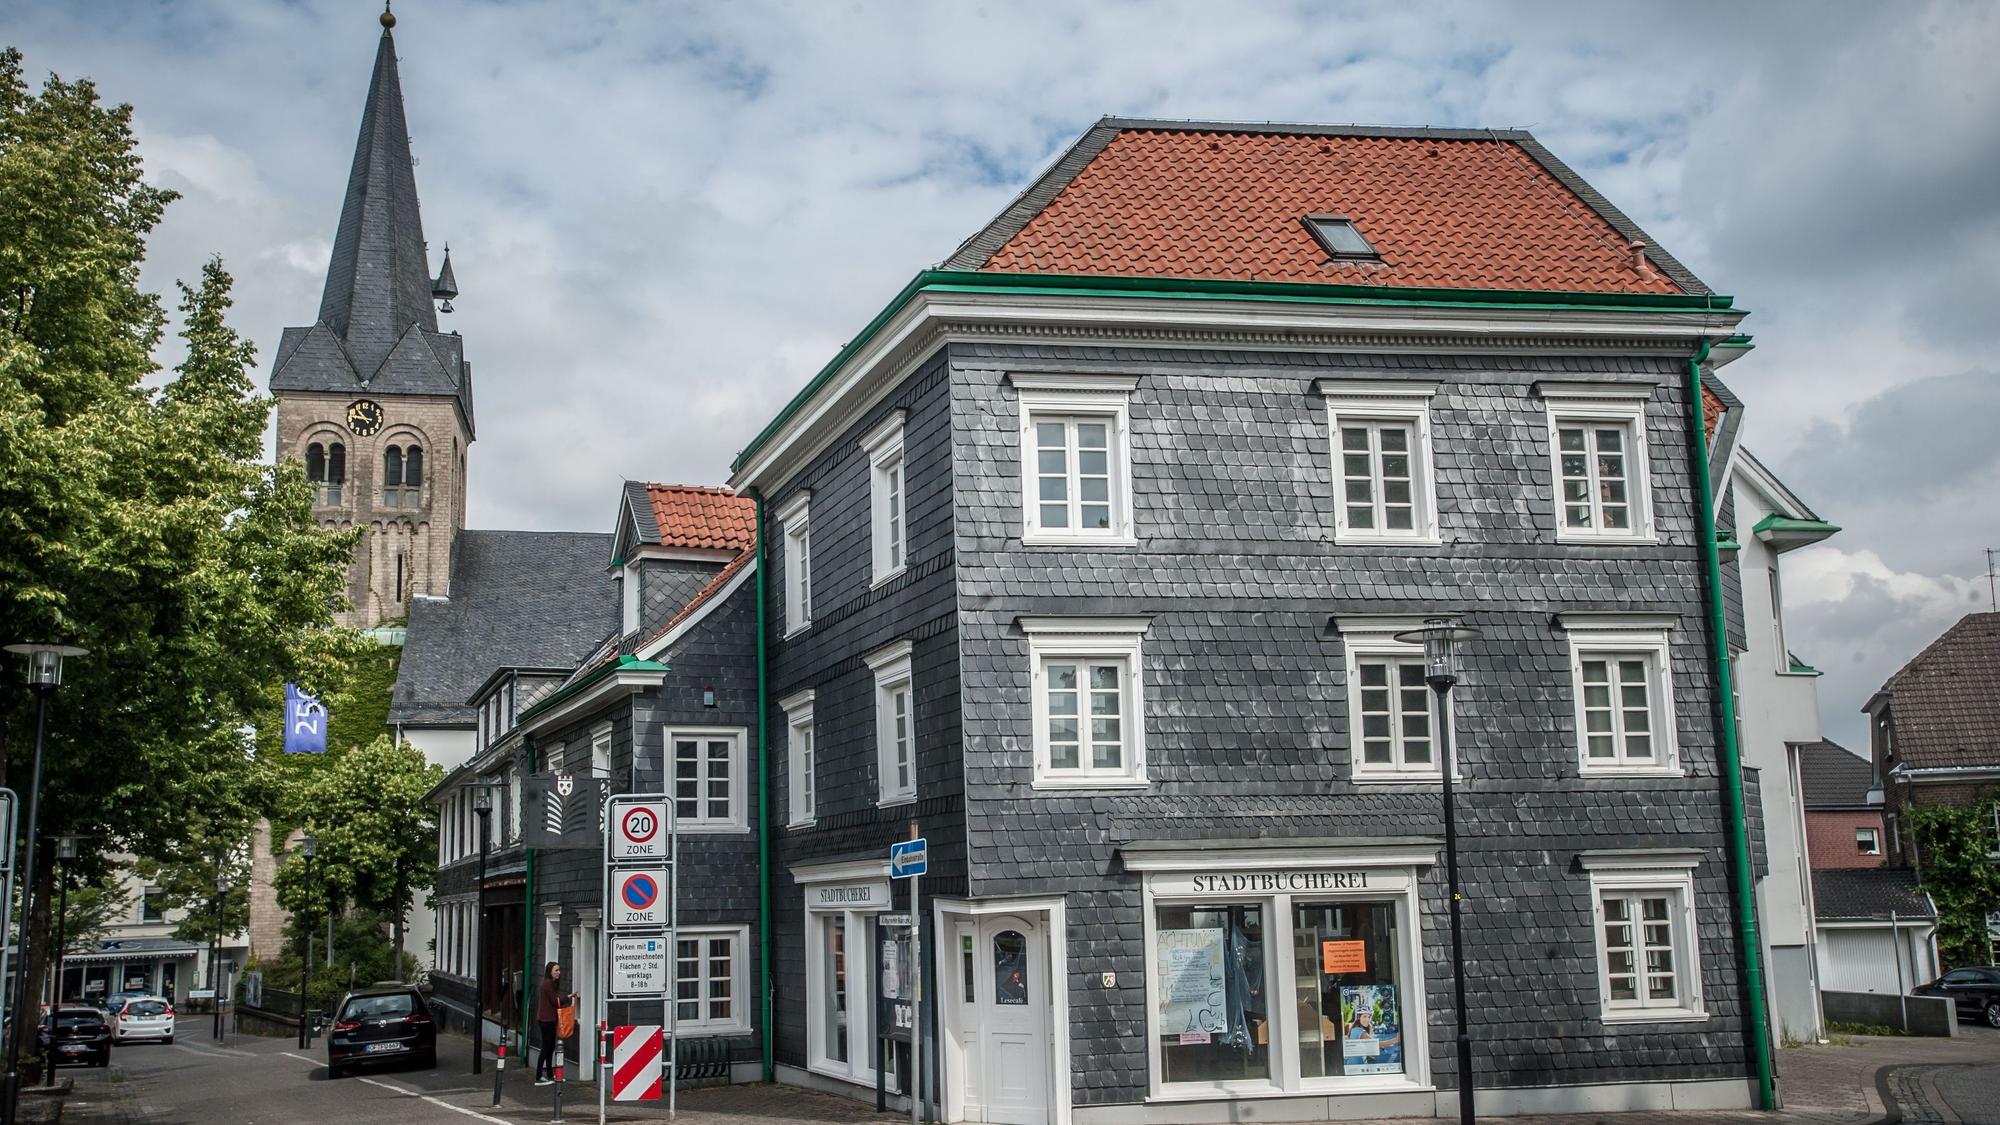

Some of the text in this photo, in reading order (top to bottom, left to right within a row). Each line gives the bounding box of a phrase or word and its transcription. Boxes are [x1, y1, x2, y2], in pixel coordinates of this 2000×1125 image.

[630, 816, 651, 834] 20
[626, 844, 654, 855] ZONE
[1193, 871, 1368, 892] STADTBÜCHEREI
[820, 886, 871, 903] STADTBÜCHEREI
[626, 911, 654, 922] ZONE
[615, 953, 664, 962] gekennzeichneten
[620, 962, 641, 970] Flächen
[642, 962, 647, 970] 2
[627, 972, 652, 980] werktags
